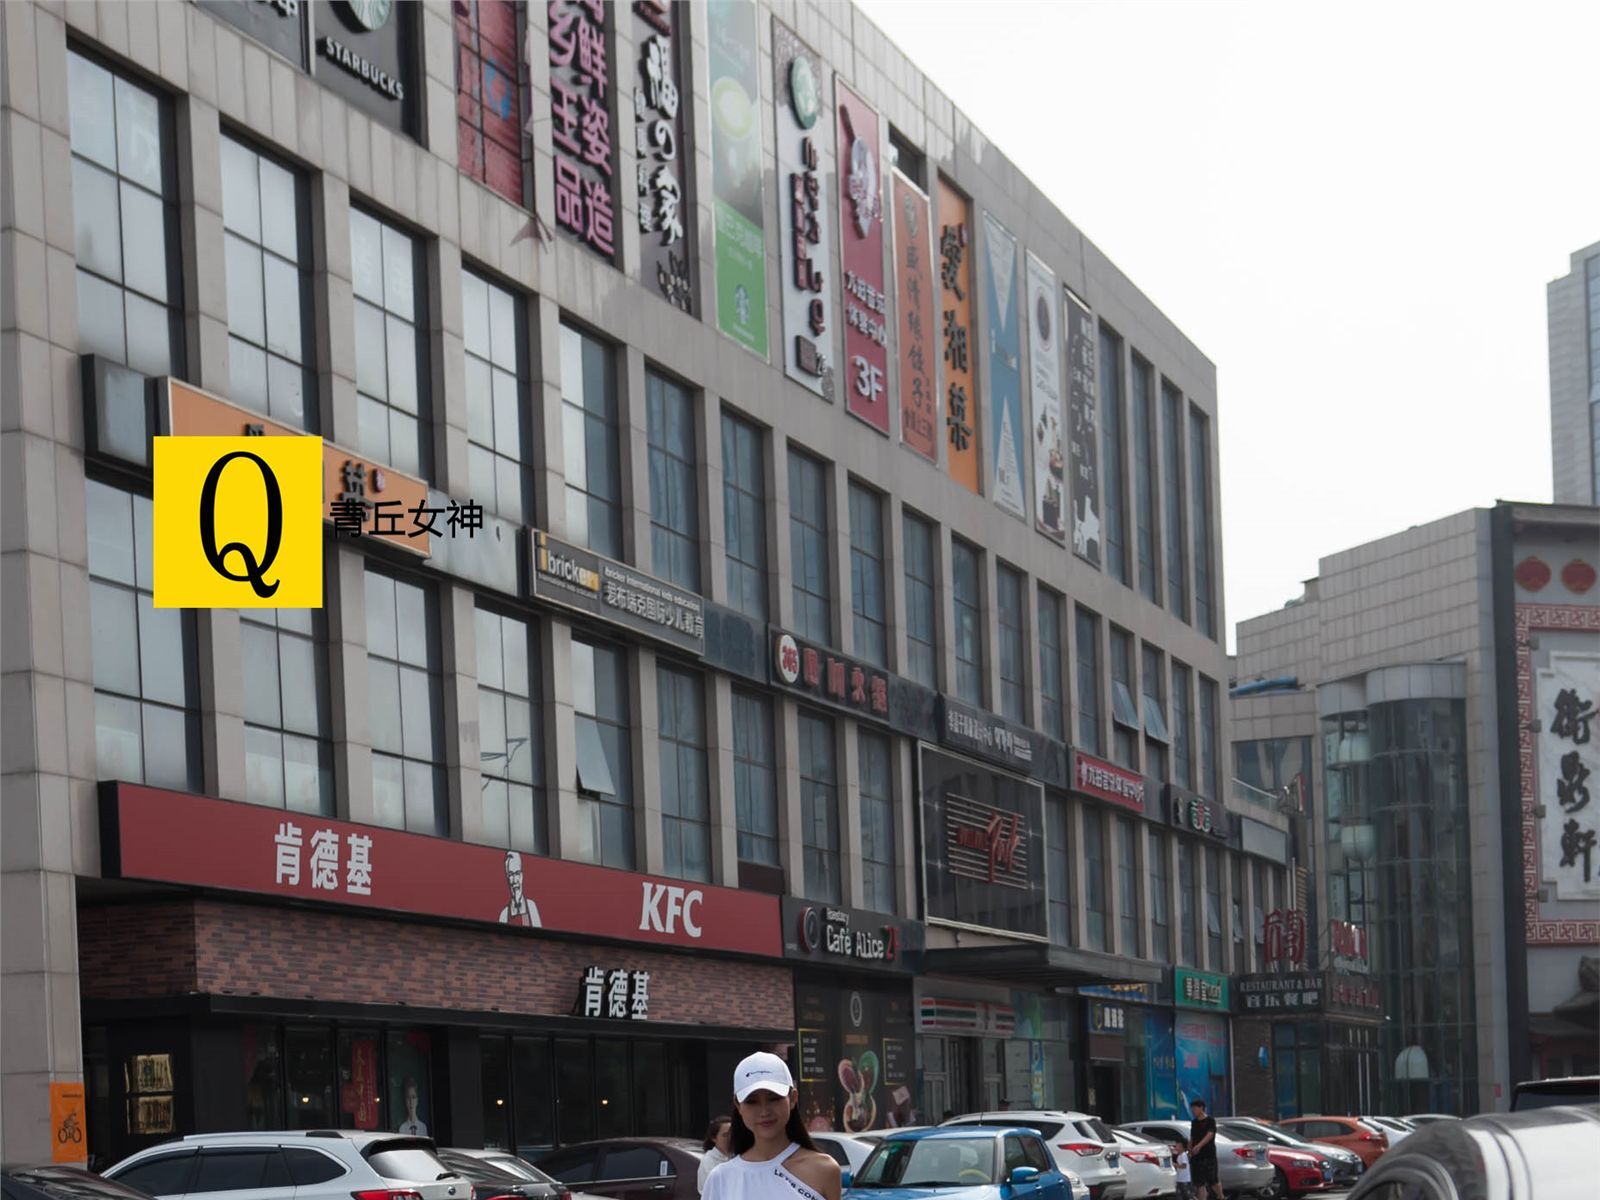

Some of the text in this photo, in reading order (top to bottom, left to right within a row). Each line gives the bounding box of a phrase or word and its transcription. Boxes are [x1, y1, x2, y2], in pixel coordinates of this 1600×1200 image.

[325, 36, 404, 100] STARBUCKS
[854, 355, 884, 402] 3F
[605, 581, 703, 638] 爱布瑞克国际少儿教育
[274, 822, 373, 896] 肯德基
[639, 881, 704, 938] KFC
[826, 924, 852, 955] Café
[856, 931, 884, 959] Alice
[585, 966, 651, 1020] 肯德基
